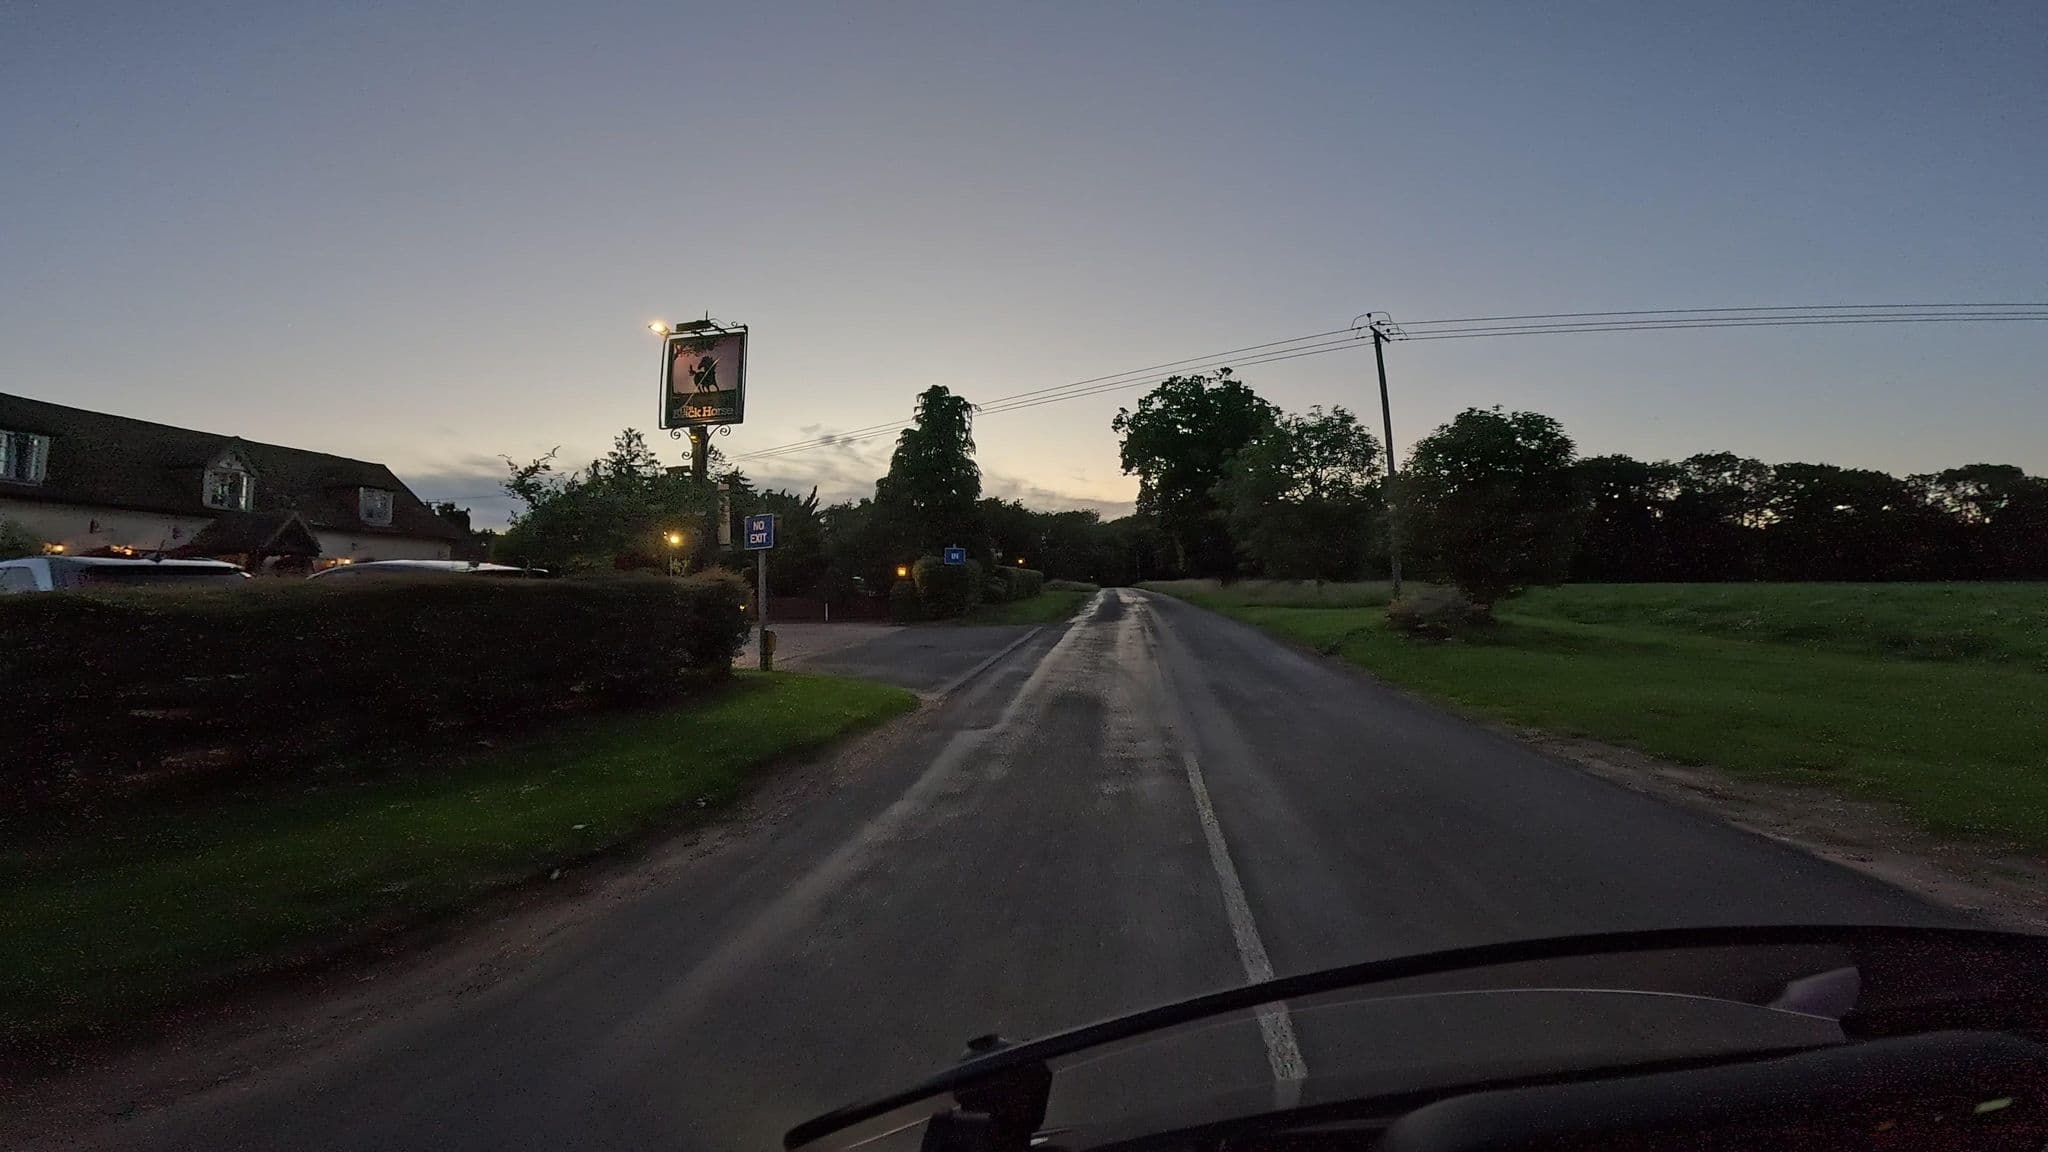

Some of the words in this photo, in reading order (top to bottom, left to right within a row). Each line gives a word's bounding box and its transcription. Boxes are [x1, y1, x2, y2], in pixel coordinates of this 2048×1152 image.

[702, 405, 734, 417] Horse
[752, 520, 765, 531] NO
[750, 532, 768, 544] EXIT
[950, 552, 960, 560] IN
